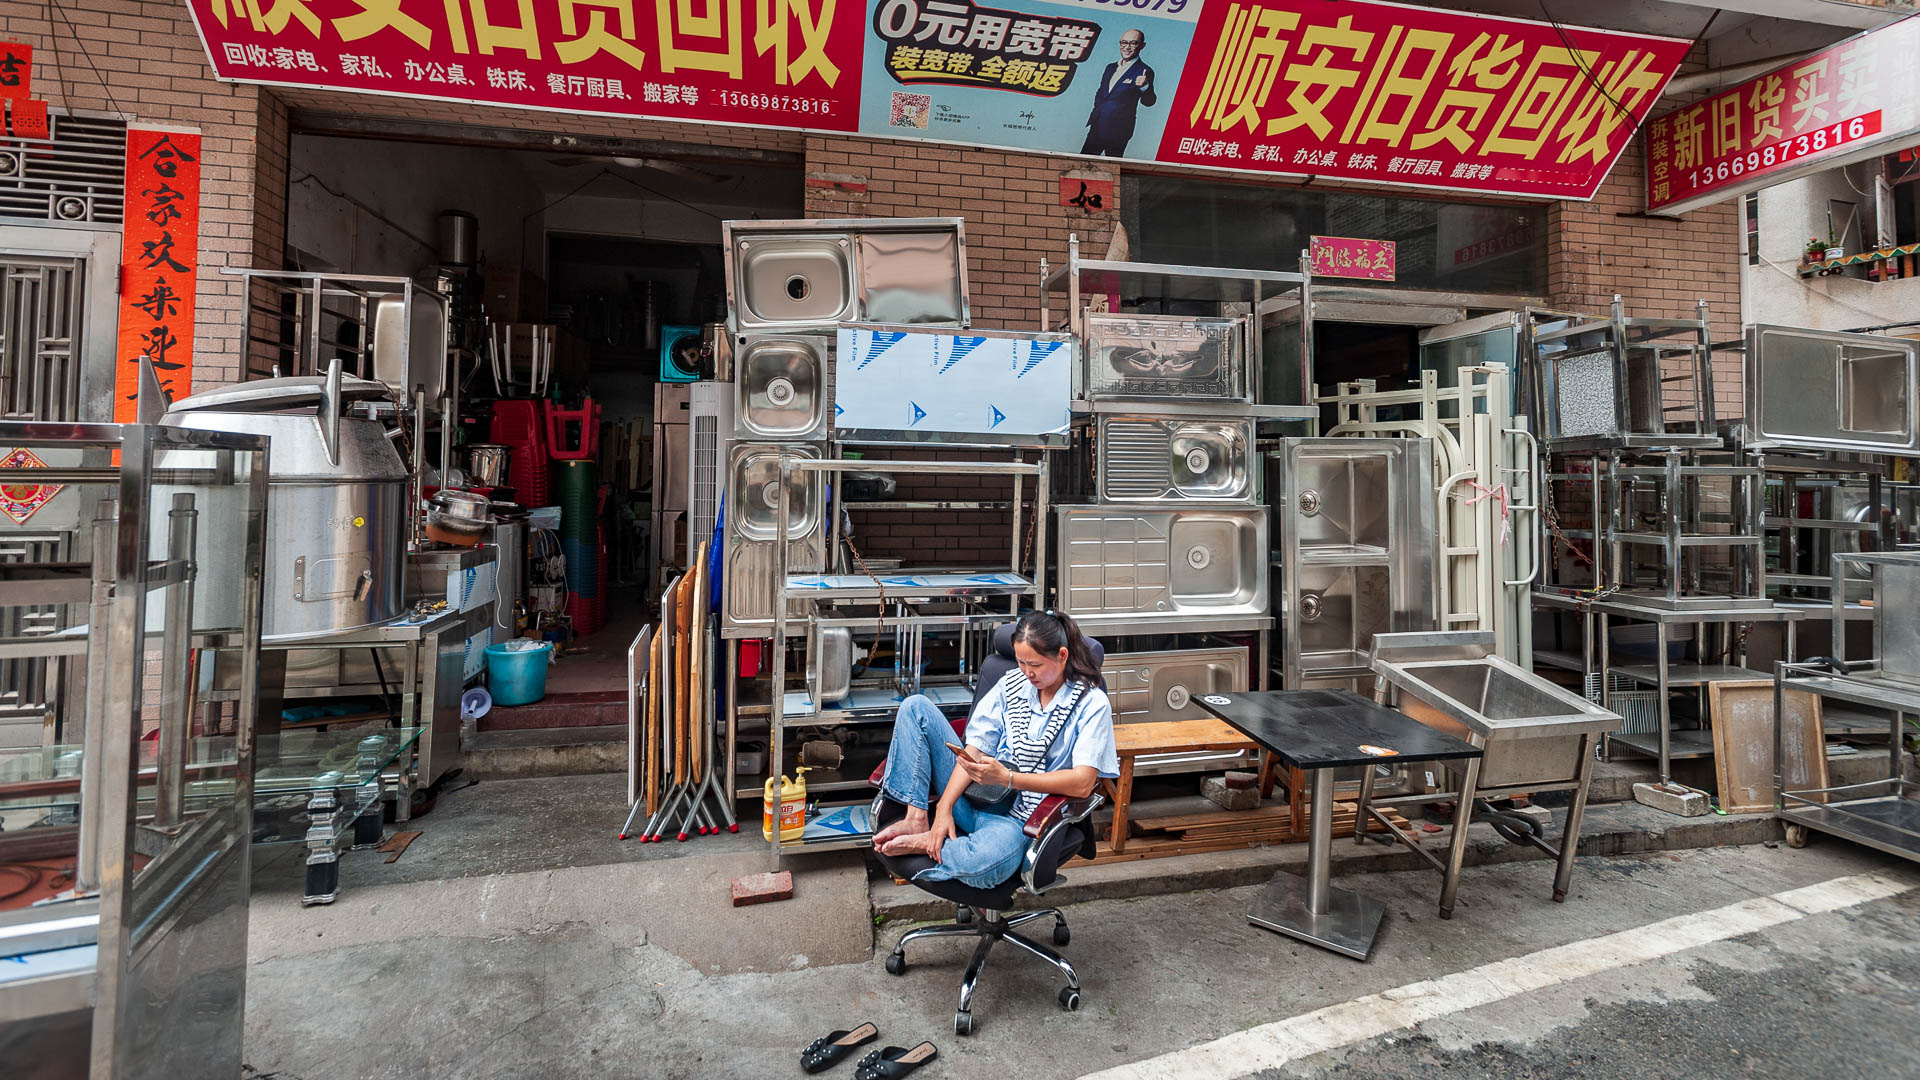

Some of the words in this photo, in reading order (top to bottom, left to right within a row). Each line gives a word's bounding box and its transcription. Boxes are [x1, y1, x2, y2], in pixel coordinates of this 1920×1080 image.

[879, 0, 1095, 59] 0元用宽带
[0, 52, 26, 86] 吉
[719, 92, 830, 114] 13669873816
[1190, 3, 1664, 166] 顺安旧货回收
[1673, 36, 1879, 171] 新旧货买卖
[1651, 118, 1670, 202] 拆装空调
[1689, 117, 1865, 189] 13669873816
